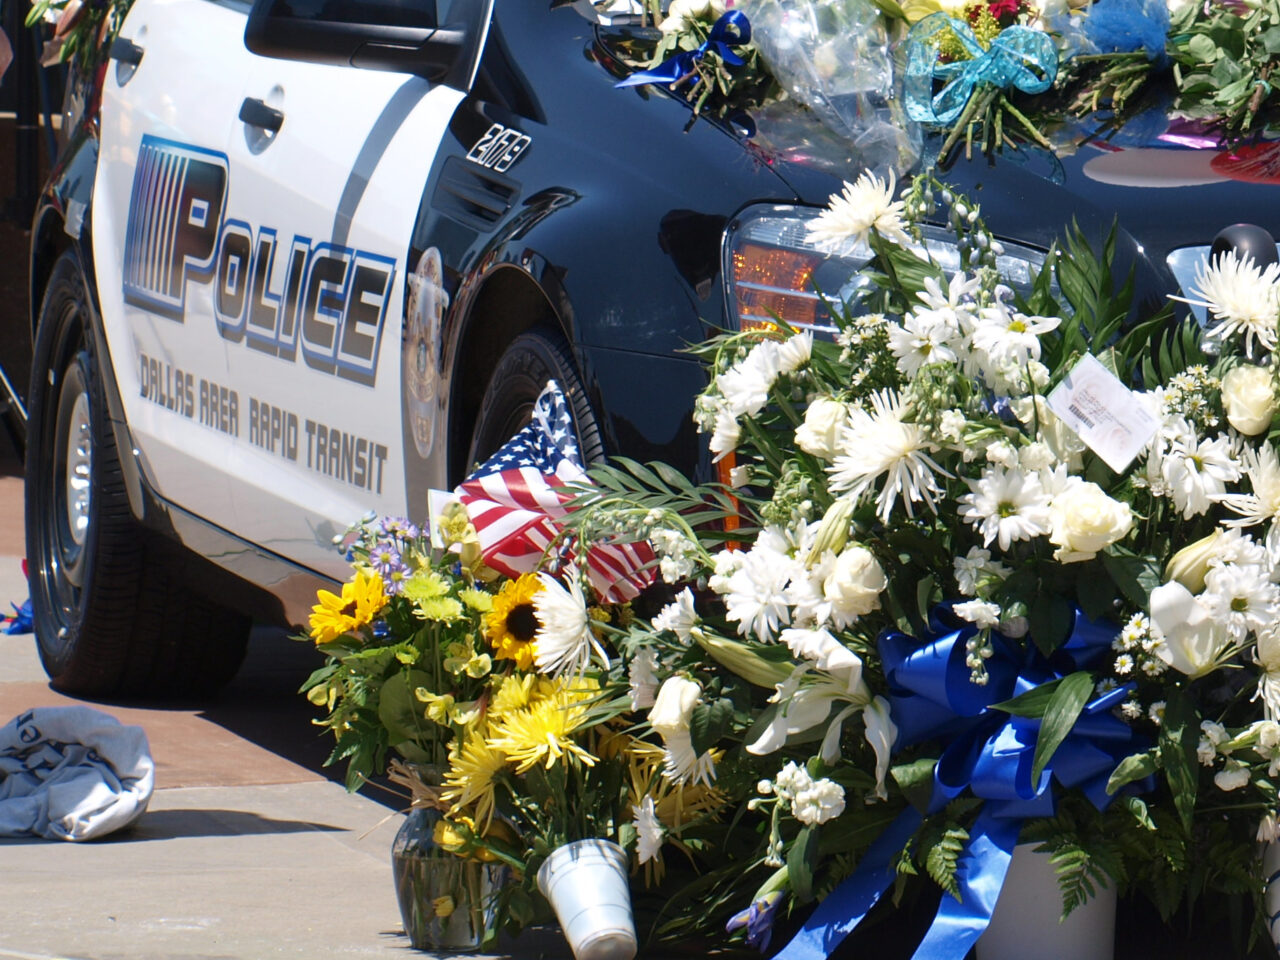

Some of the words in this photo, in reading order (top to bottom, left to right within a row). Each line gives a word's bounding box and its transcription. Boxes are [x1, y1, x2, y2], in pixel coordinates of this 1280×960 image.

[124, 134, 397, 388] POLICE
[140, 353, 195, 418] DALLAS
[199, 378, 240, 438] AREA
[249, 397, 299, 462] RAPID
[305, 420, 389, 496] TRANSIT
